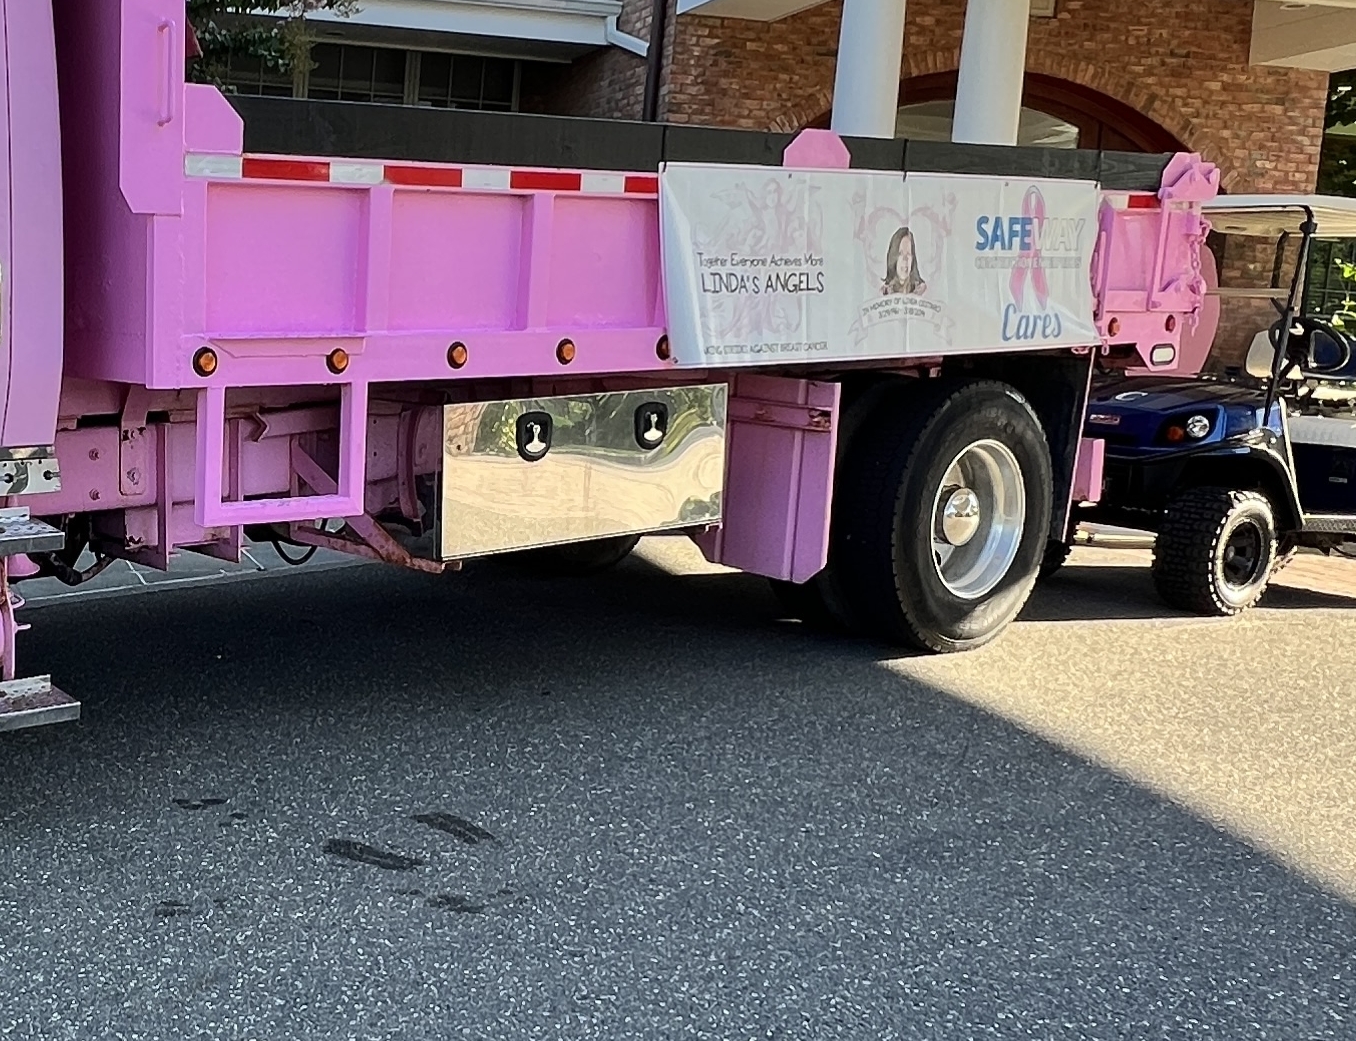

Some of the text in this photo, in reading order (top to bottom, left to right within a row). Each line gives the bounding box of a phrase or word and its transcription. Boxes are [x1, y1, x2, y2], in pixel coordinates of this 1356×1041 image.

[701, 270, 825, 294] LINDA'S ANGELS
[1002, 303, 1062, 342] Cares
